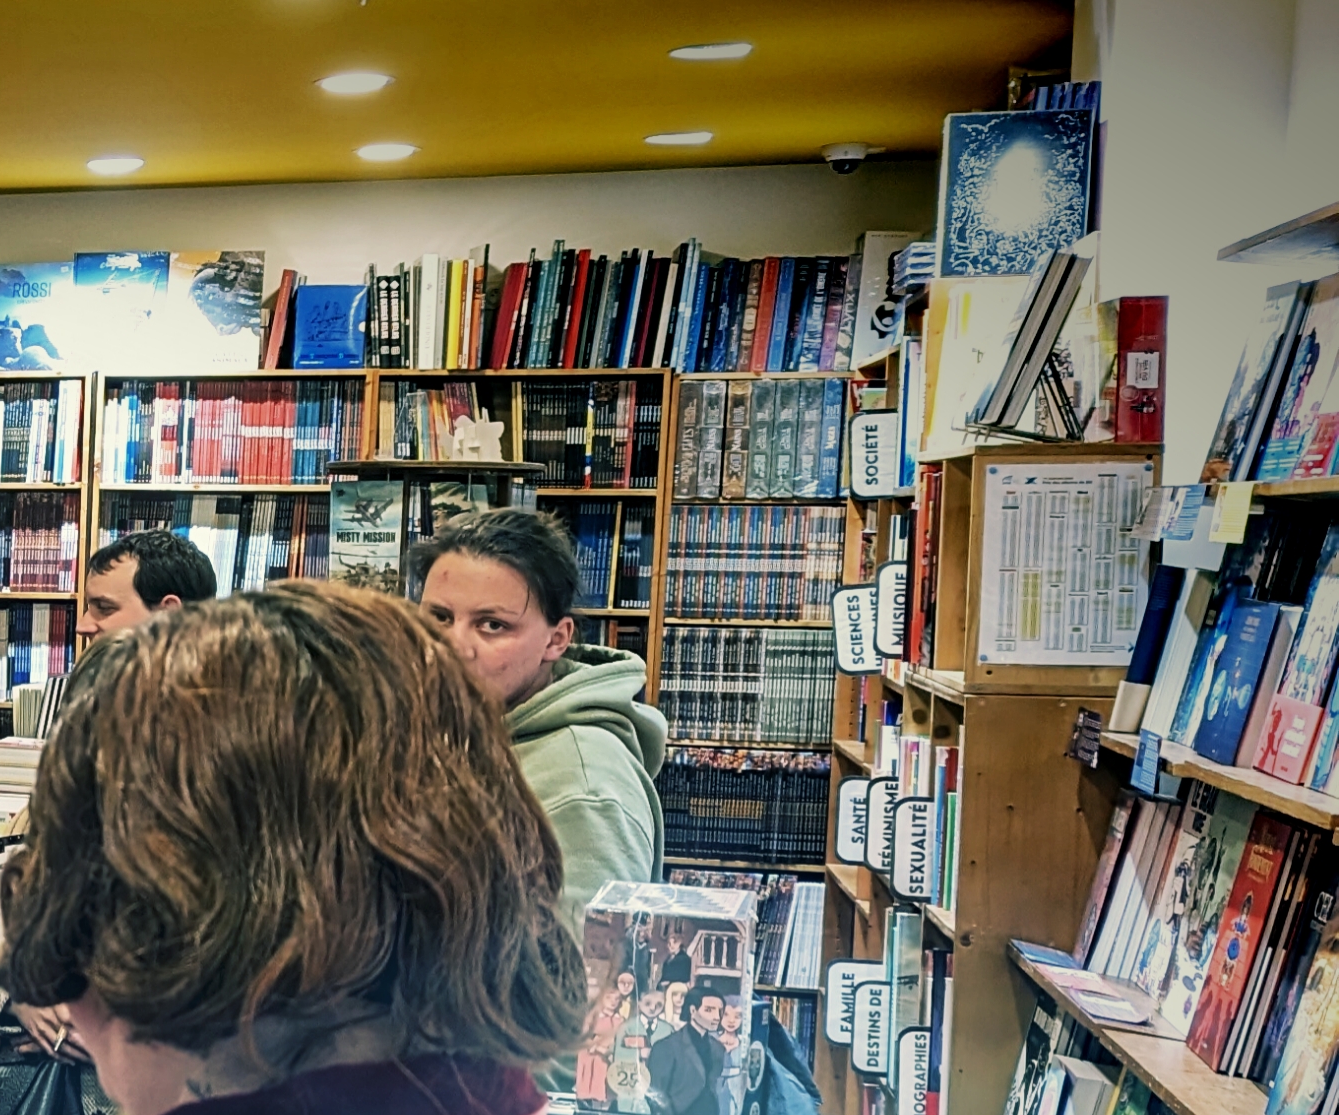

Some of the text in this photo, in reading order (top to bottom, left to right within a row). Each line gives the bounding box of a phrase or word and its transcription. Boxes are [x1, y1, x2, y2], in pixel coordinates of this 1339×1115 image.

[13, 282, 52, 298] ROSSI
[865, 423, 879, 486] SOCIÉTÉ
[336, 531, 396, 543] MISTY MISSION
[846, 594, 865, 665] SCIENCES
[850, 797, 867, 844] SANTÉ
[878, 782, 899, 867] FÉMINISME
[908, 804, 928, 894] SEXUALITÉ
[840, 972, 855, 1033] FAMILLE
[867, 989, 882, 1067] DESTINS DE
